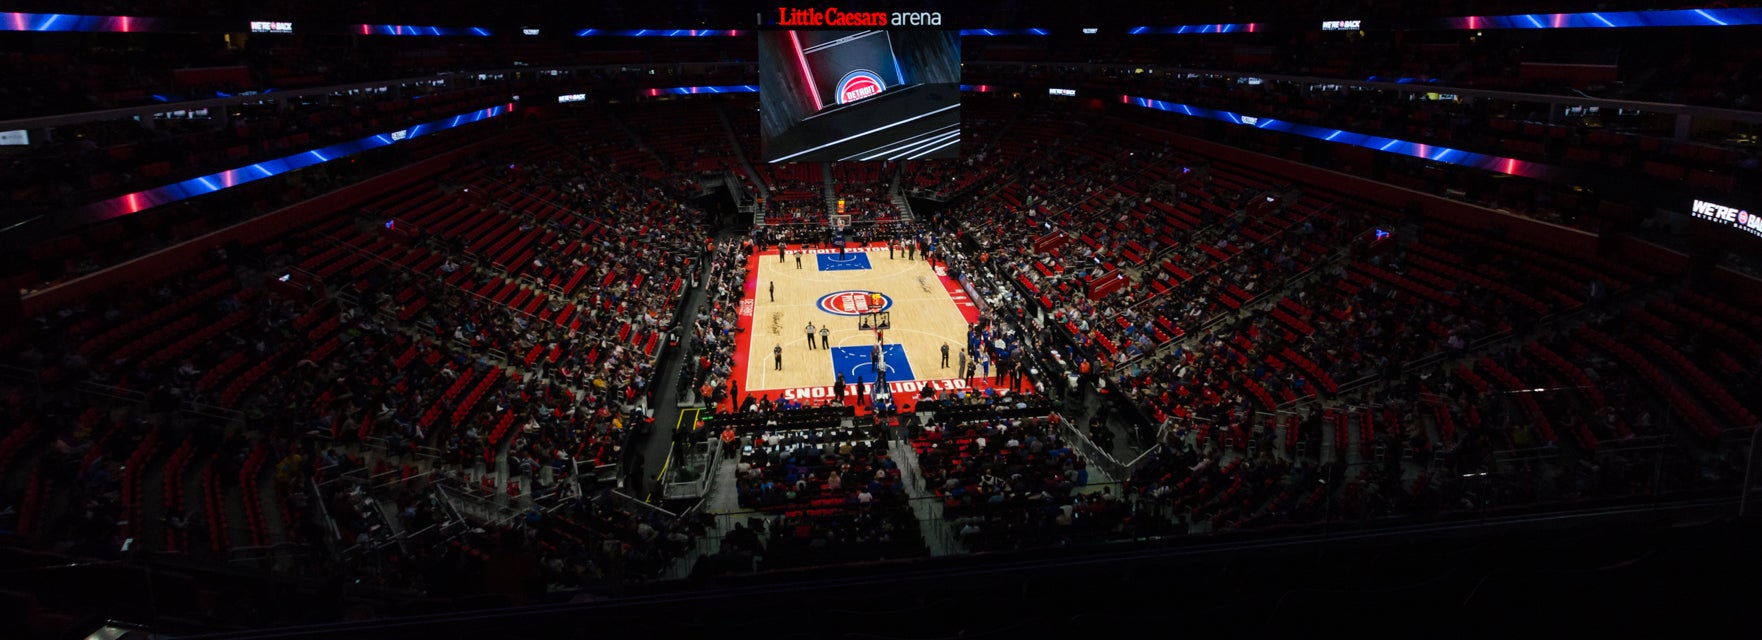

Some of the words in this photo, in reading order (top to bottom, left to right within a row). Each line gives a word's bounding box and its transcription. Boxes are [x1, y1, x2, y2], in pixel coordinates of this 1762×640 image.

[779, 7, 823, 26] Little
[825, 7, 888, 26] Caesars
[891, 12, 942, 26] arena
[276, 22, 293, 31] BACK
[846, 85, 875, 99] DETROIT
[1692, 199, 1739, 222] WE'RE
[1747, 214, 1762, 233] BA
